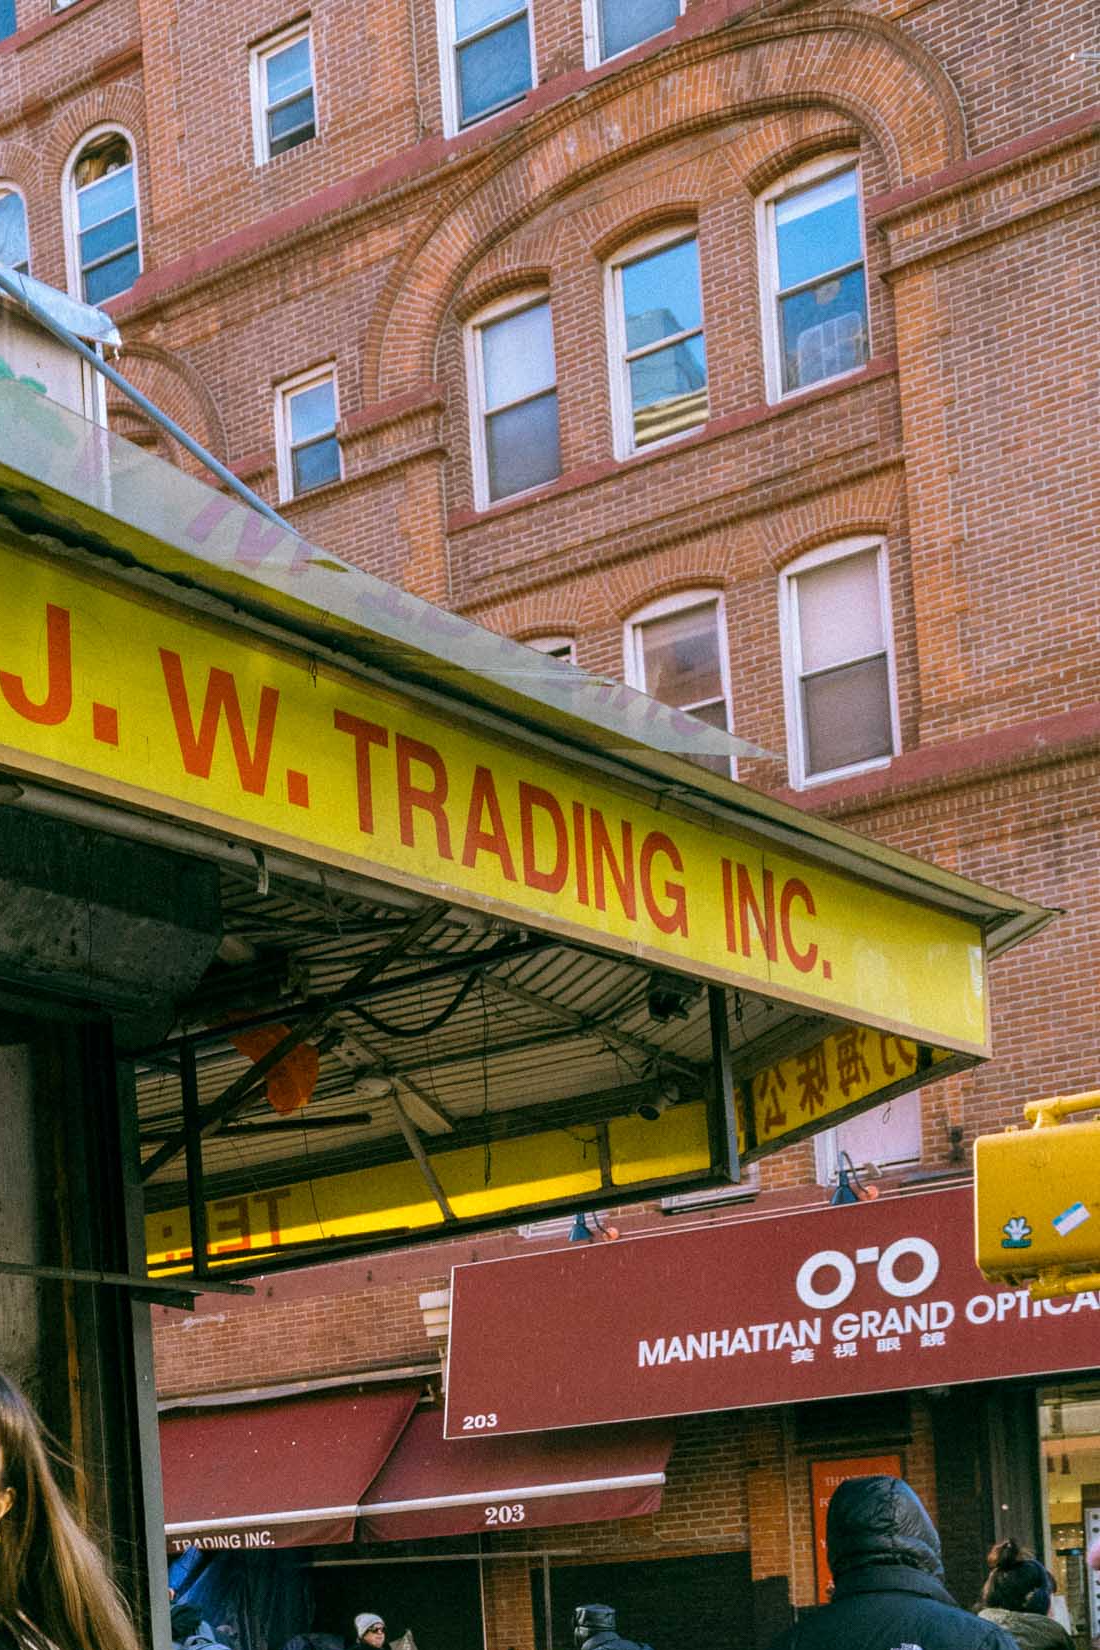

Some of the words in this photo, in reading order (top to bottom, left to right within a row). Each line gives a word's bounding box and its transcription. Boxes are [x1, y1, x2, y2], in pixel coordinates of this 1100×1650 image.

[159, 647, 309, 808] W.
[332, 709, 689, 938] TRADING
[721, 857, 833, 980] INC.
[638, 1318, 821, 1367] MANHATTAN
[832, 1300, 955, 1341] GRAND
[965, 1289, 1100, 1325] OPTICA
[462, 1413, 498, 1430] 203
[485, 1505, 525, 1526] 203
[245, 1531, 275, 1550] INC.
